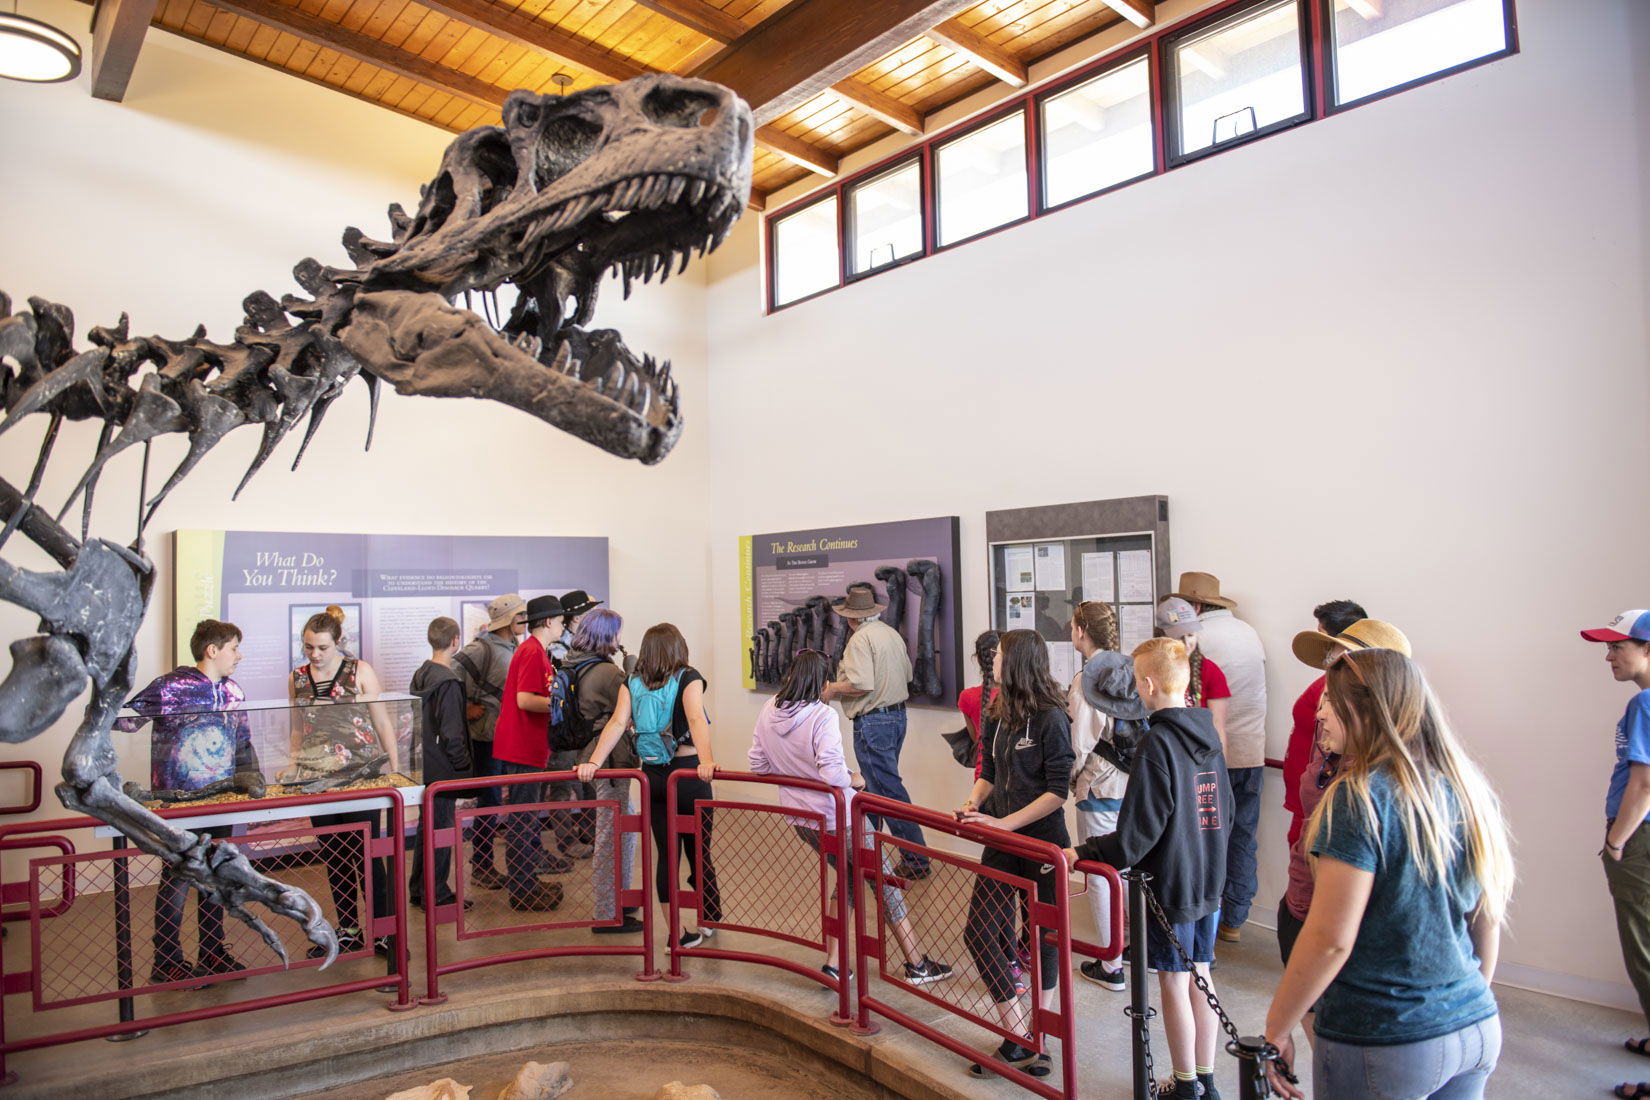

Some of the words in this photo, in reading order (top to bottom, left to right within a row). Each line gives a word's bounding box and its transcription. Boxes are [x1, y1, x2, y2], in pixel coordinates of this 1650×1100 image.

[771, 542, 785, 554] The
[787, 539, 817, 553] Research
[820, 538, 858, 550] Continues
[256, 552, 296, 567] What
[302, 552, 324, 567] Do
[242, 569, 272, 586] You
[278, 568, 337, 586] Think?
